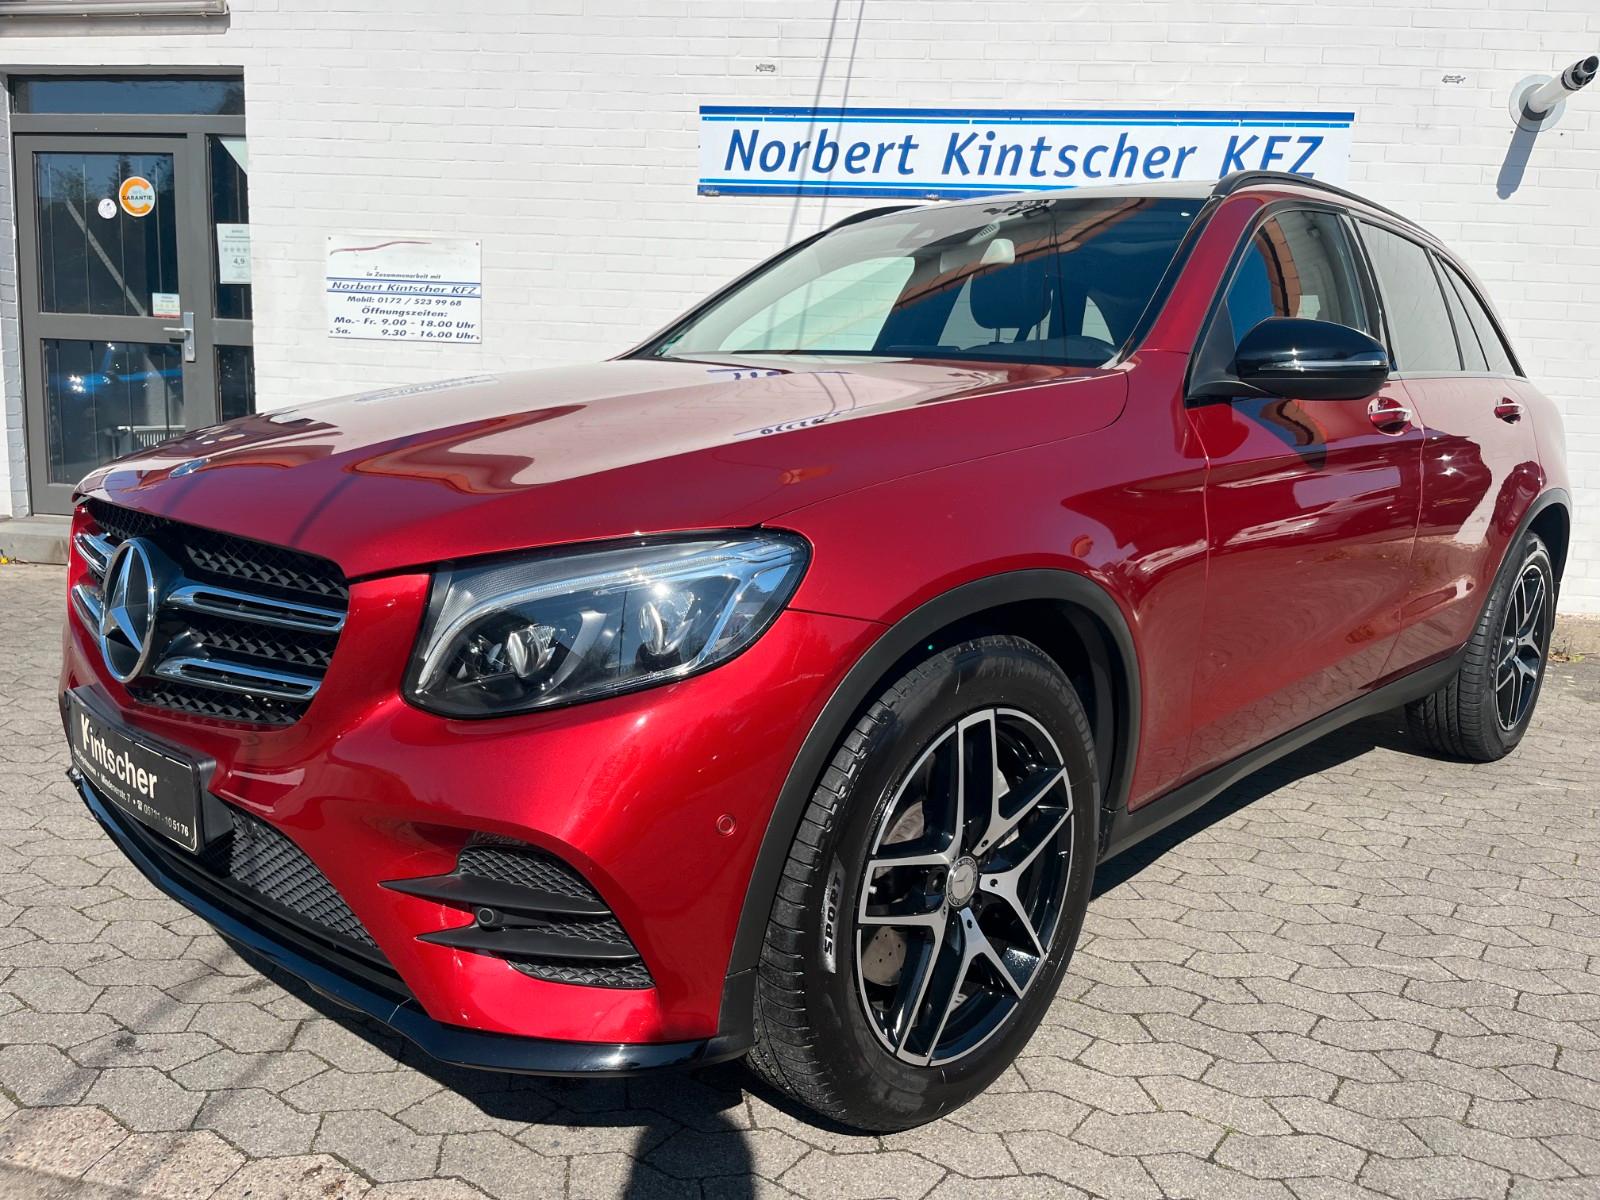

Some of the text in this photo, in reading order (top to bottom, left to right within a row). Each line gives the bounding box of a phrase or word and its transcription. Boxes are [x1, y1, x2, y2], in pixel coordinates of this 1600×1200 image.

[724, 128, 1326, 180] Norbert Kintscher KFZ
[332, 281, 477, 295] Norbert Kintscher KFZ
[377, 296, 401, 304] 0172
[414, 298, 432, 306] 523
[361, 305, 448, 318] Öffnungszeiten:
[381, 318, 407, 326] 9.00
[420, 320, 453, 328] 18.00
[456, 321, 476, 329] Uhr
[335, 327, 351, 335] Sa.
[80, 713, 157, 798] Kintscher
[823, 871, 841, 956] SPORT
